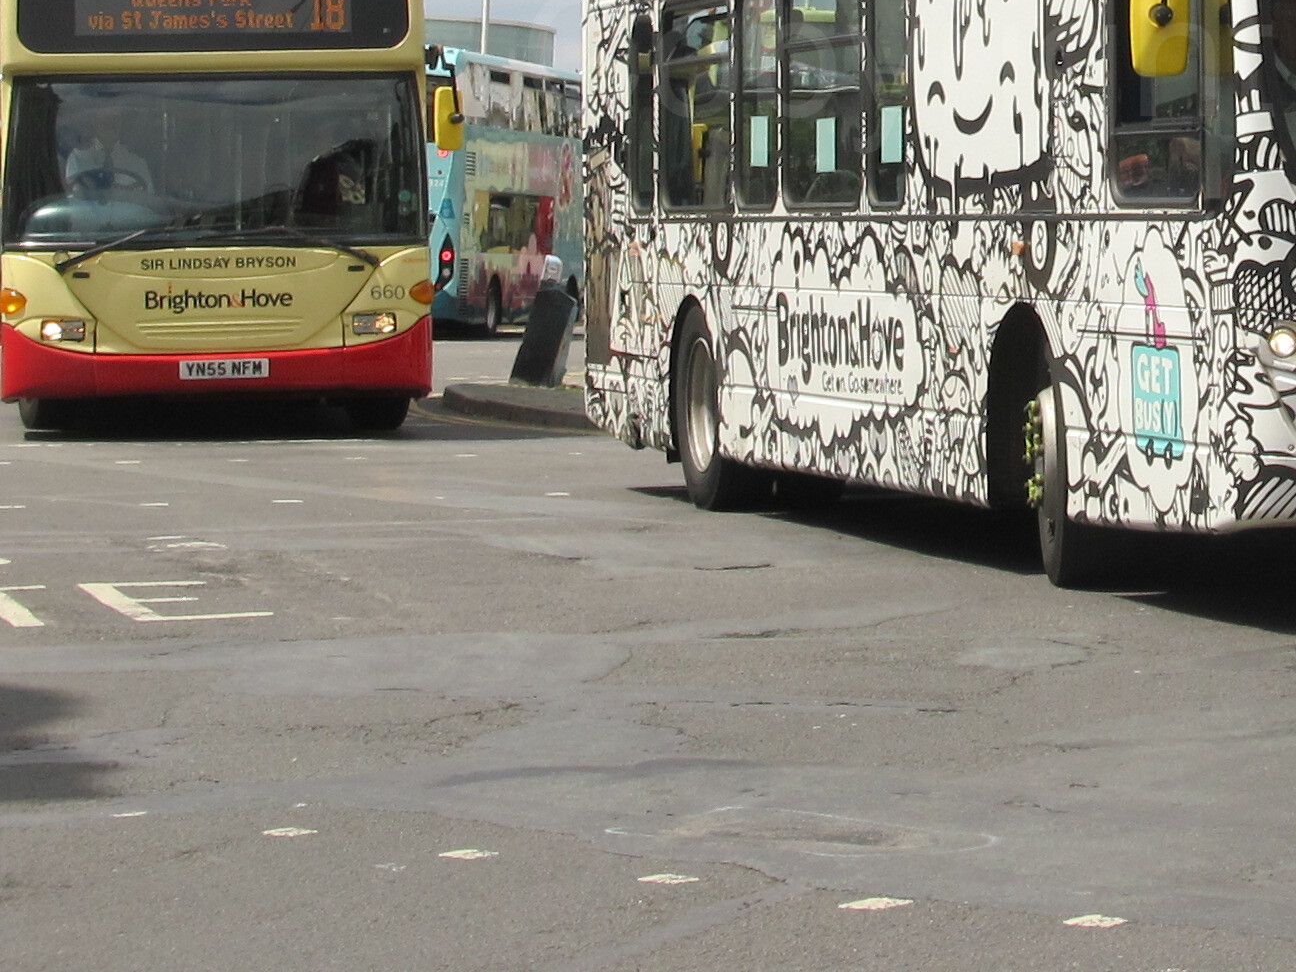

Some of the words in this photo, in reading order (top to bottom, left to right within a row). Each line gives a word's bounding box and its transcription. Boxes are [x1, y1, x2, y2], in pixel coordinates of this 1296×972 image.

[88, 12, 115, 30] via
[121, 11, 143, 30] St
[150, 10, 228, 29] James's
[234, 10, 294, 29] Street
[141, 258, 164, 271] SIR
[169, 256, 232, 271] LINDSAY
[235, 256, 297, 269] BRYSON
[370, 284, 405, 300] 660
[185, 361, 227, 378] YN55
[231, 359, 263, 376] NFM
[1136, 353, 1174, 396] GET
